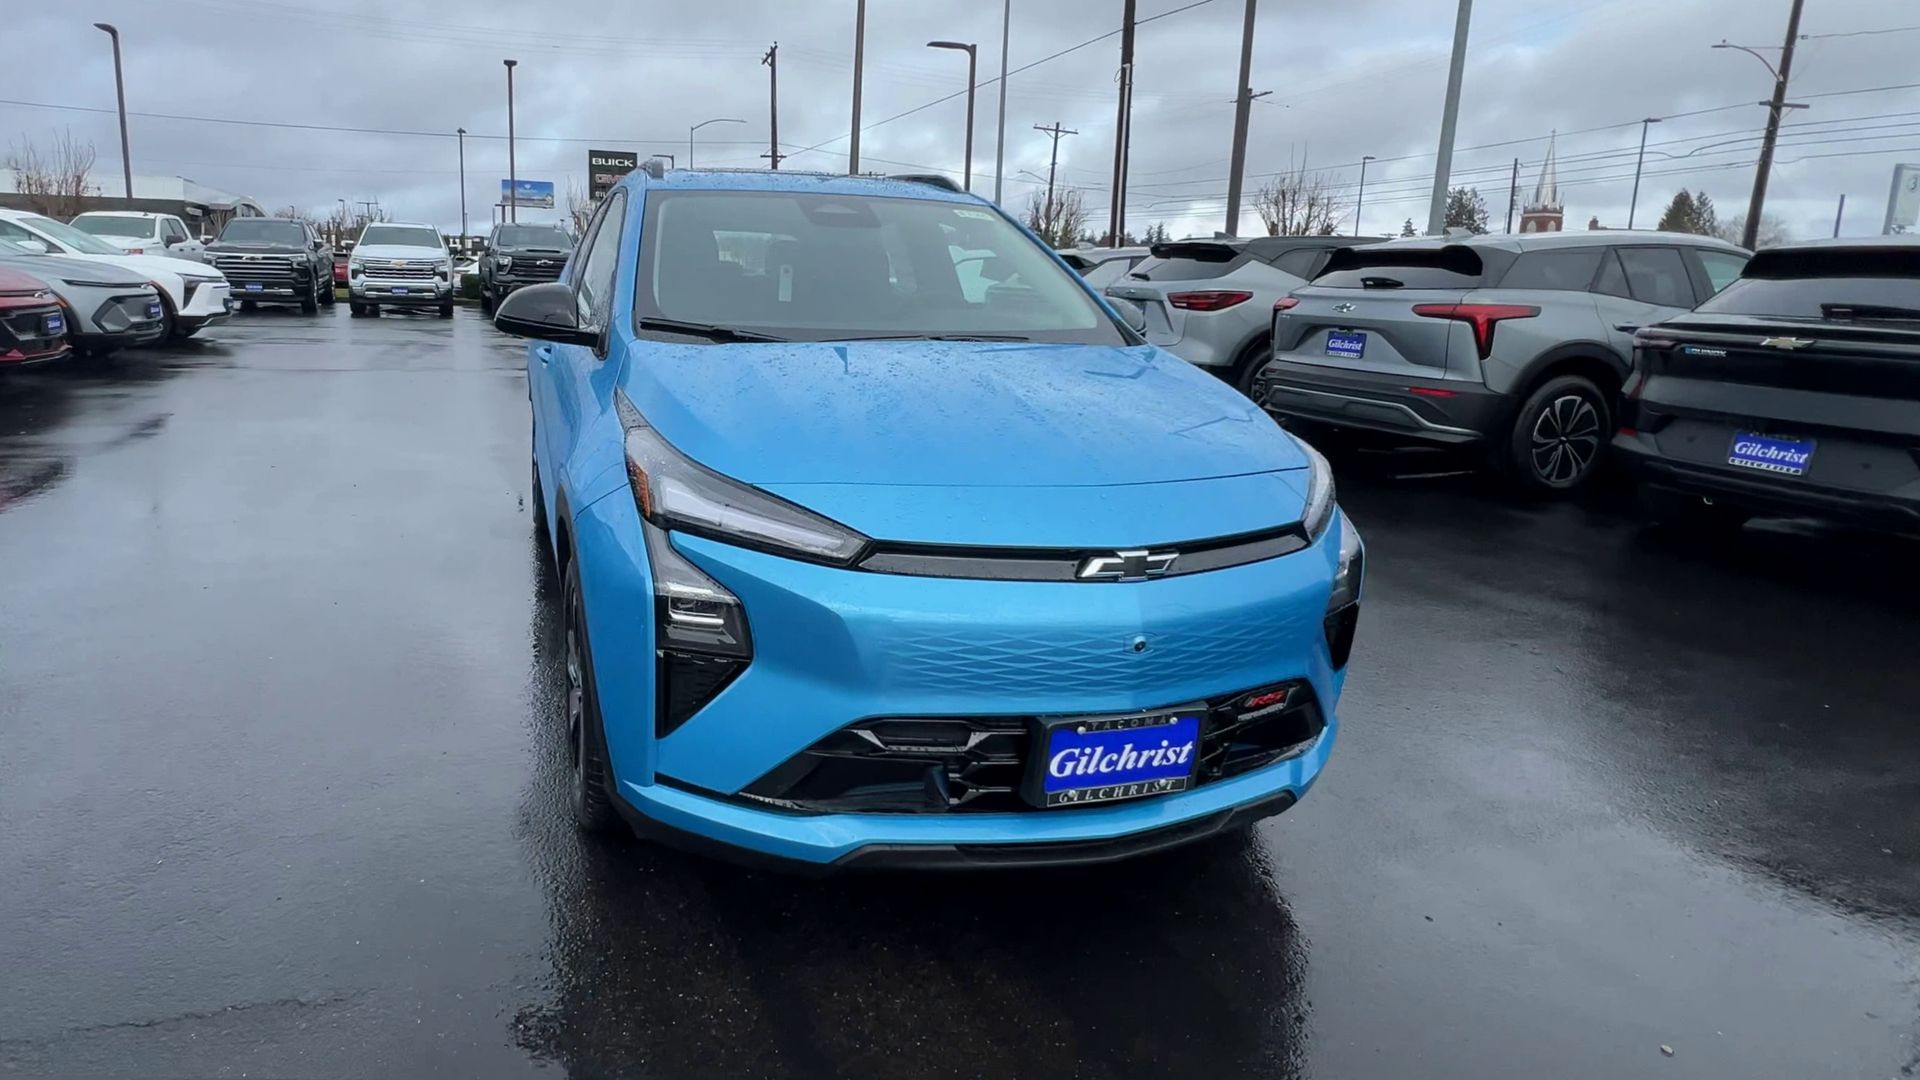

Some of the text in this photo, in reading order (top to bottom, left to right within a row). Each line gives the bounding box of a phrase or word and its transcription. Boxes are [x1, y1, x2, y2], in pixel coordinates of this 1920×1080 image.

[592, 157, 633, 167] BUICK
[1328, 339, 1362, 351] Gilchrist
[1734, 441, 1808, 463] Gilchrist
[1091, 717, 1166, 731] TACOMA
[1049, 739, 1193, 778] Gilchrist
[1059, 779, 1176, 804] GILCHRIST
